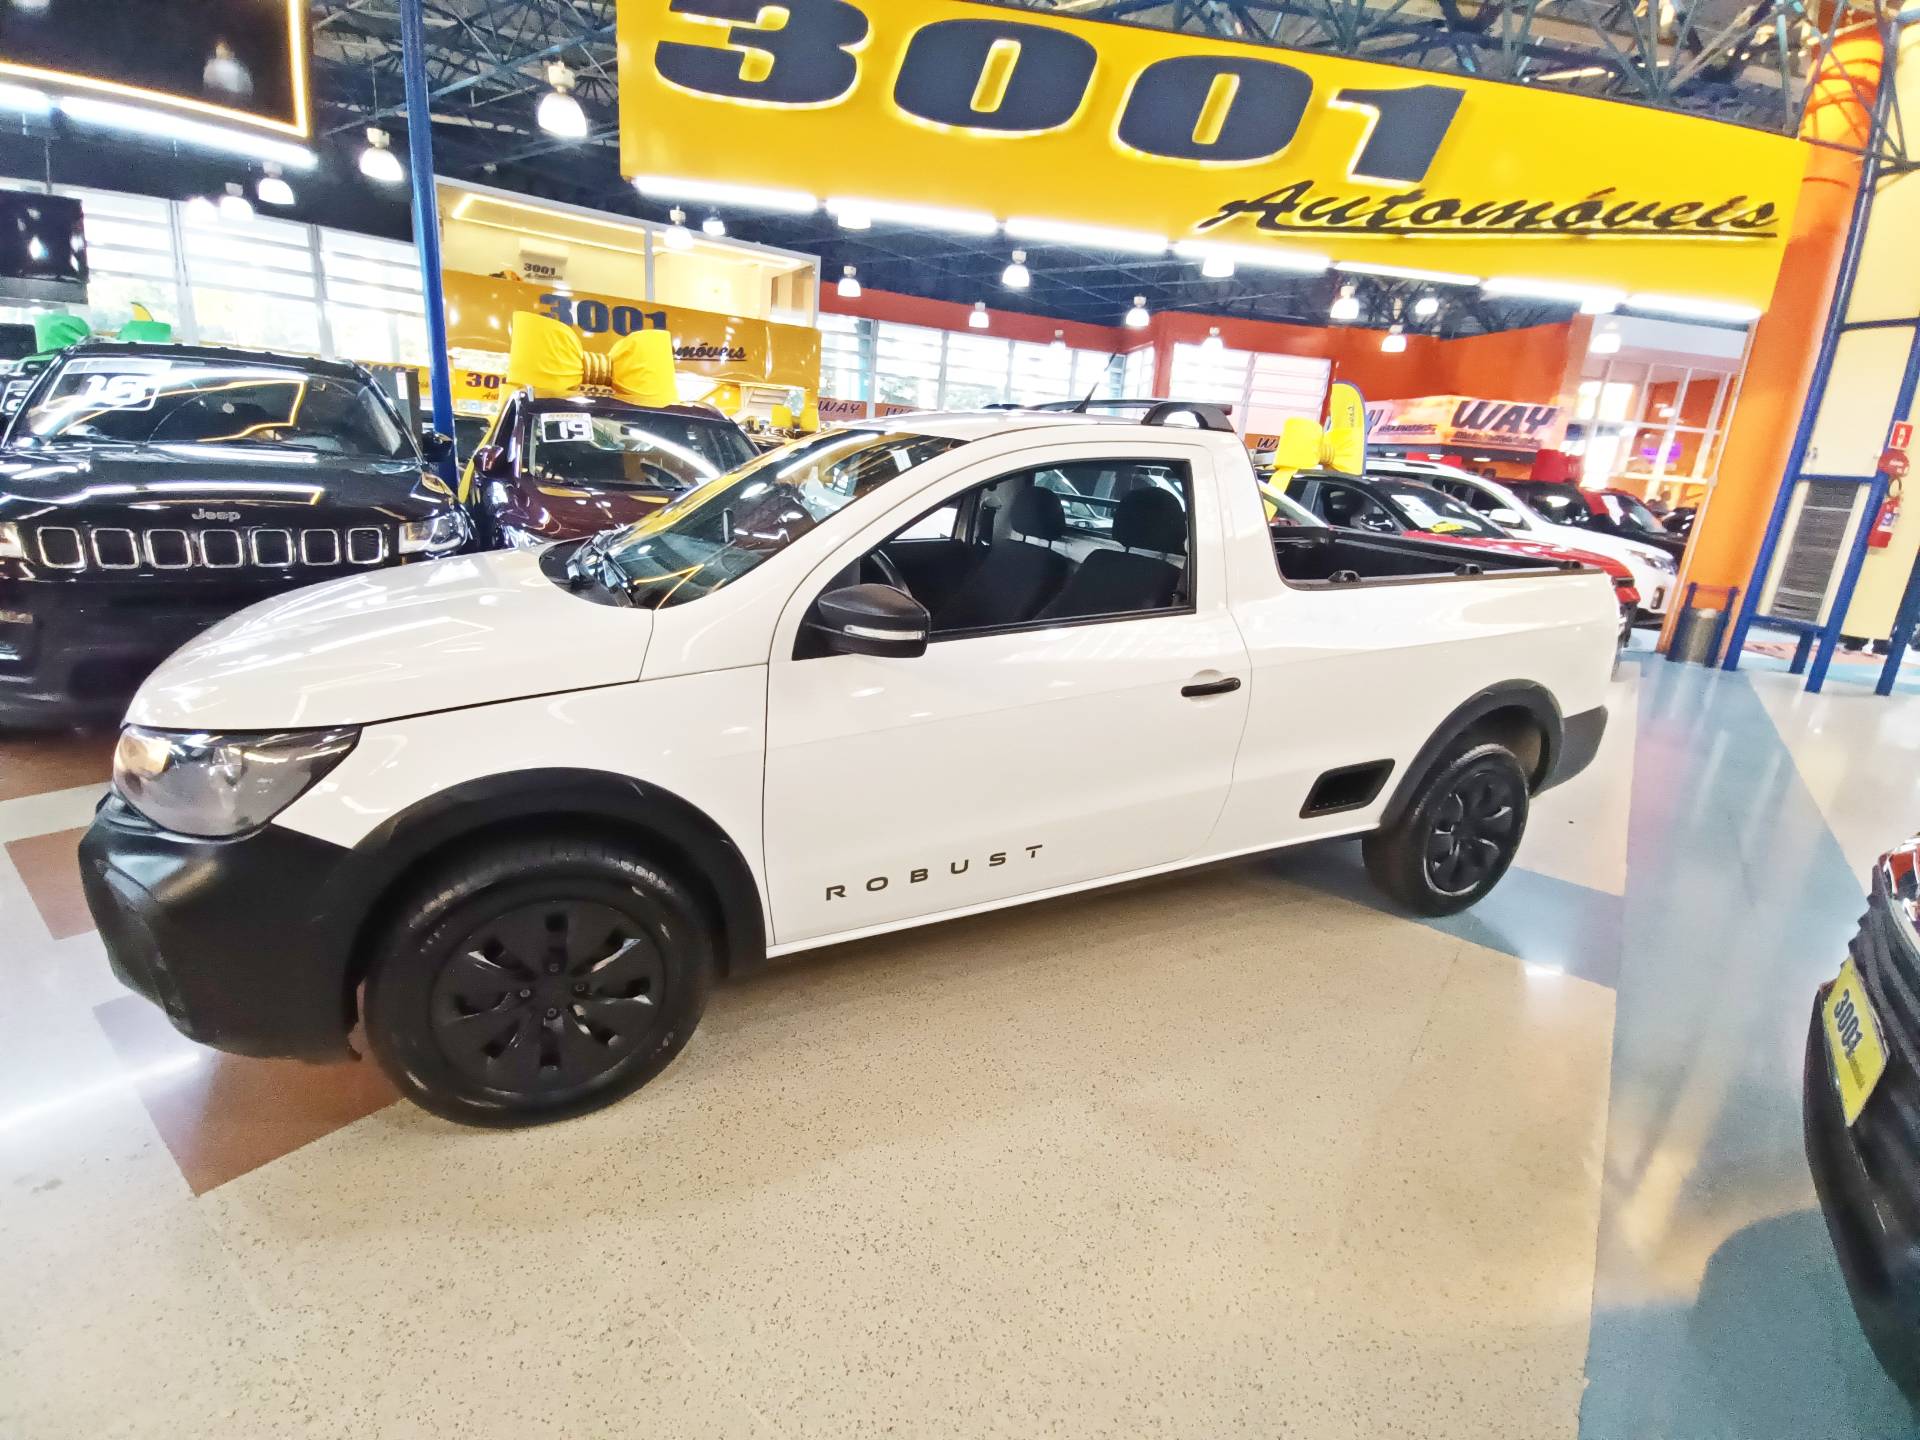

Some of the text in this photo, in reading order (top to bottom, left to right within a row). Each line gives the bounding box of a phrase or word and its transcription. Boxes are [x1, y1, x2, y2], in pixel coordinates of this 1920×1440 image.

[654, 0, 1467, 182] 3001
[1198, 178, 1781, 239] Automóveis
[818, 401, 861, 413] WAY
[1451, 400, 1558, 434] WAY
[191, 508, 241, 522] Jeep
[825, 844, 1043, 901] ROBUST
